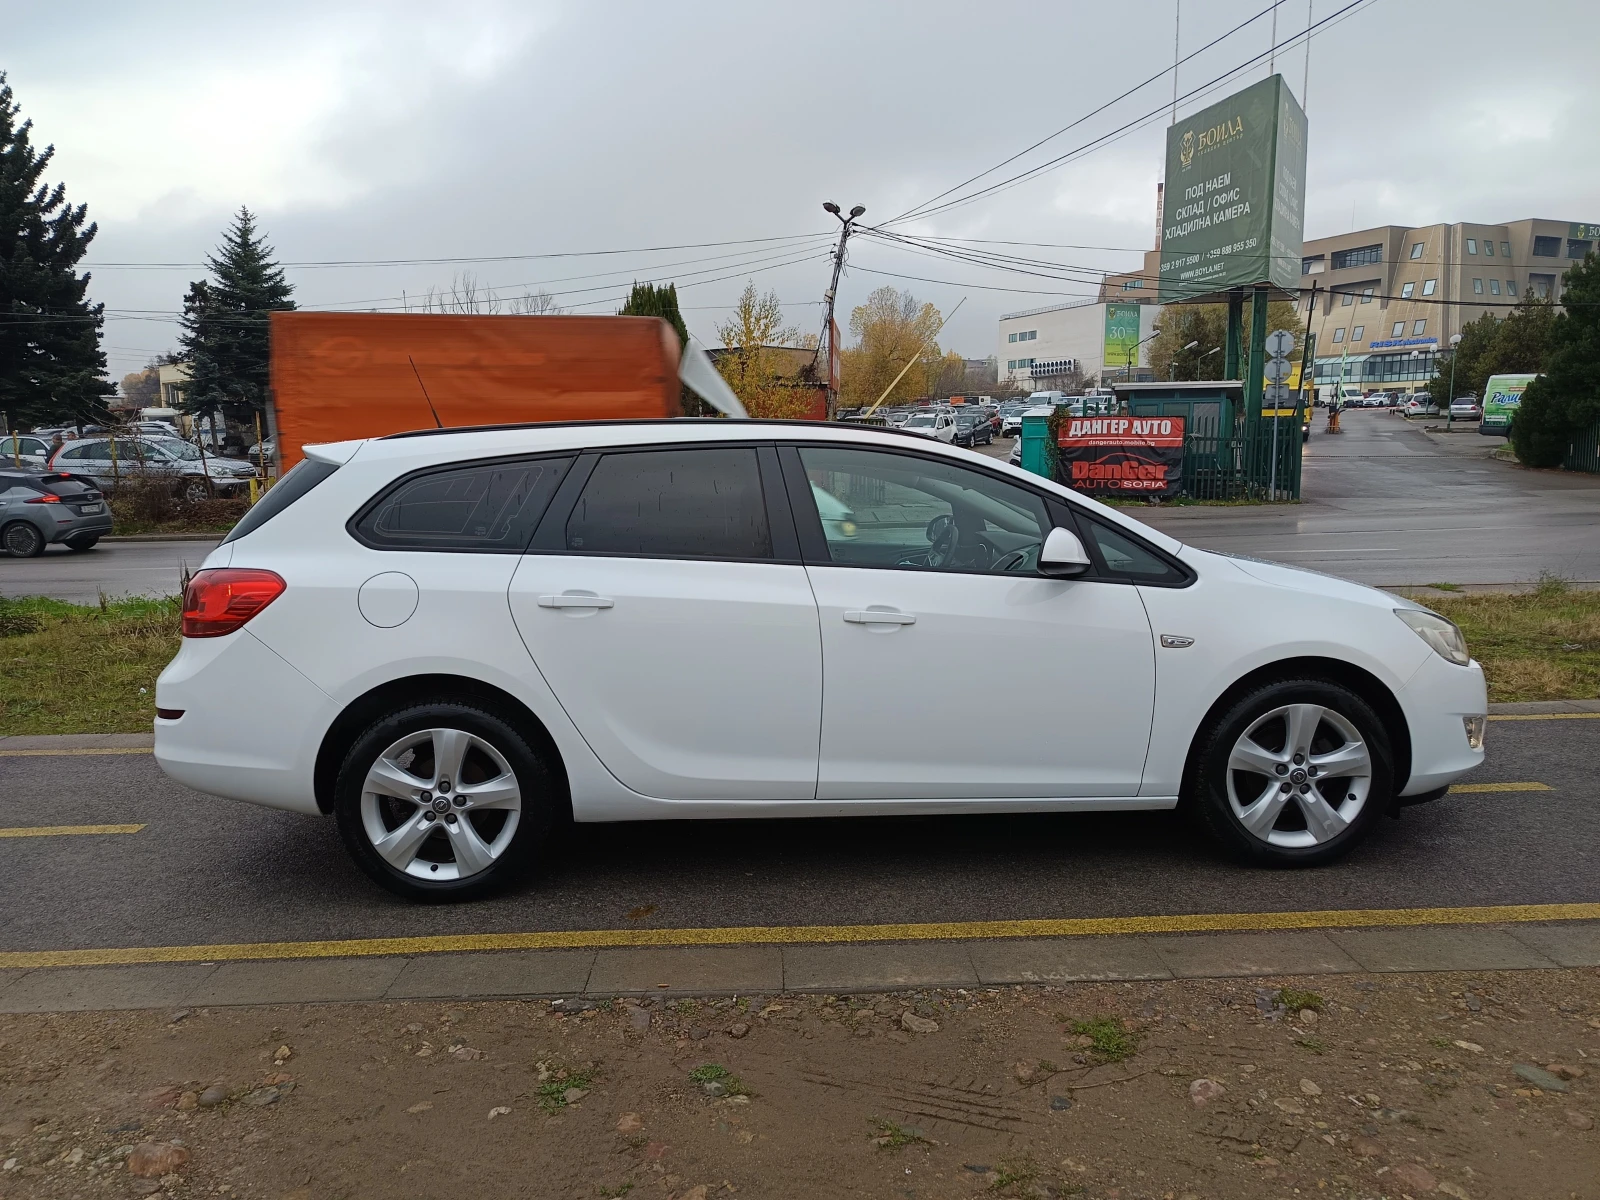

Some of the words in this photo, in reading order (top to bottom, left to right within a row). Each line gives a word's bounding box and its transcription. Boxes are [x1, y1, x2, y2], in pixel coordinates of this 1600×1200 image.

[1197, 115, 1244, 151] БОИЛА
[1185, 182, 1204, 200] ПОД
[1205, 172, 1231, 193] НАЕМ
[1176, 200, 1204, 220] СКЛАД
[1213, 187, 1240, 208] ОФИС
[1165, 215, 1211, 240] ХЛАДИЛНА
[1213, 201, 1251, 225] КАМЕРА
[1175, 257, 1185, 268] 917
[1186, 253, 1200, 265] 5500
[1233, 240, 1244, 253] 955
[1245, 237, 1257, 249] 350
[1180, 262, 1225, 280] WWW.BOYLA.NET
[1109, 326, 1126, 340] 30
[1069, 419, 1129, 437] ДАНГЕР
[1131, 419, 1171, 435] АУТО
[1072, 460, 1168, 479] DanGer
[1072, 480, 1120, 489] AUTO
[1123, 480, 1165, 488] SOFIA
